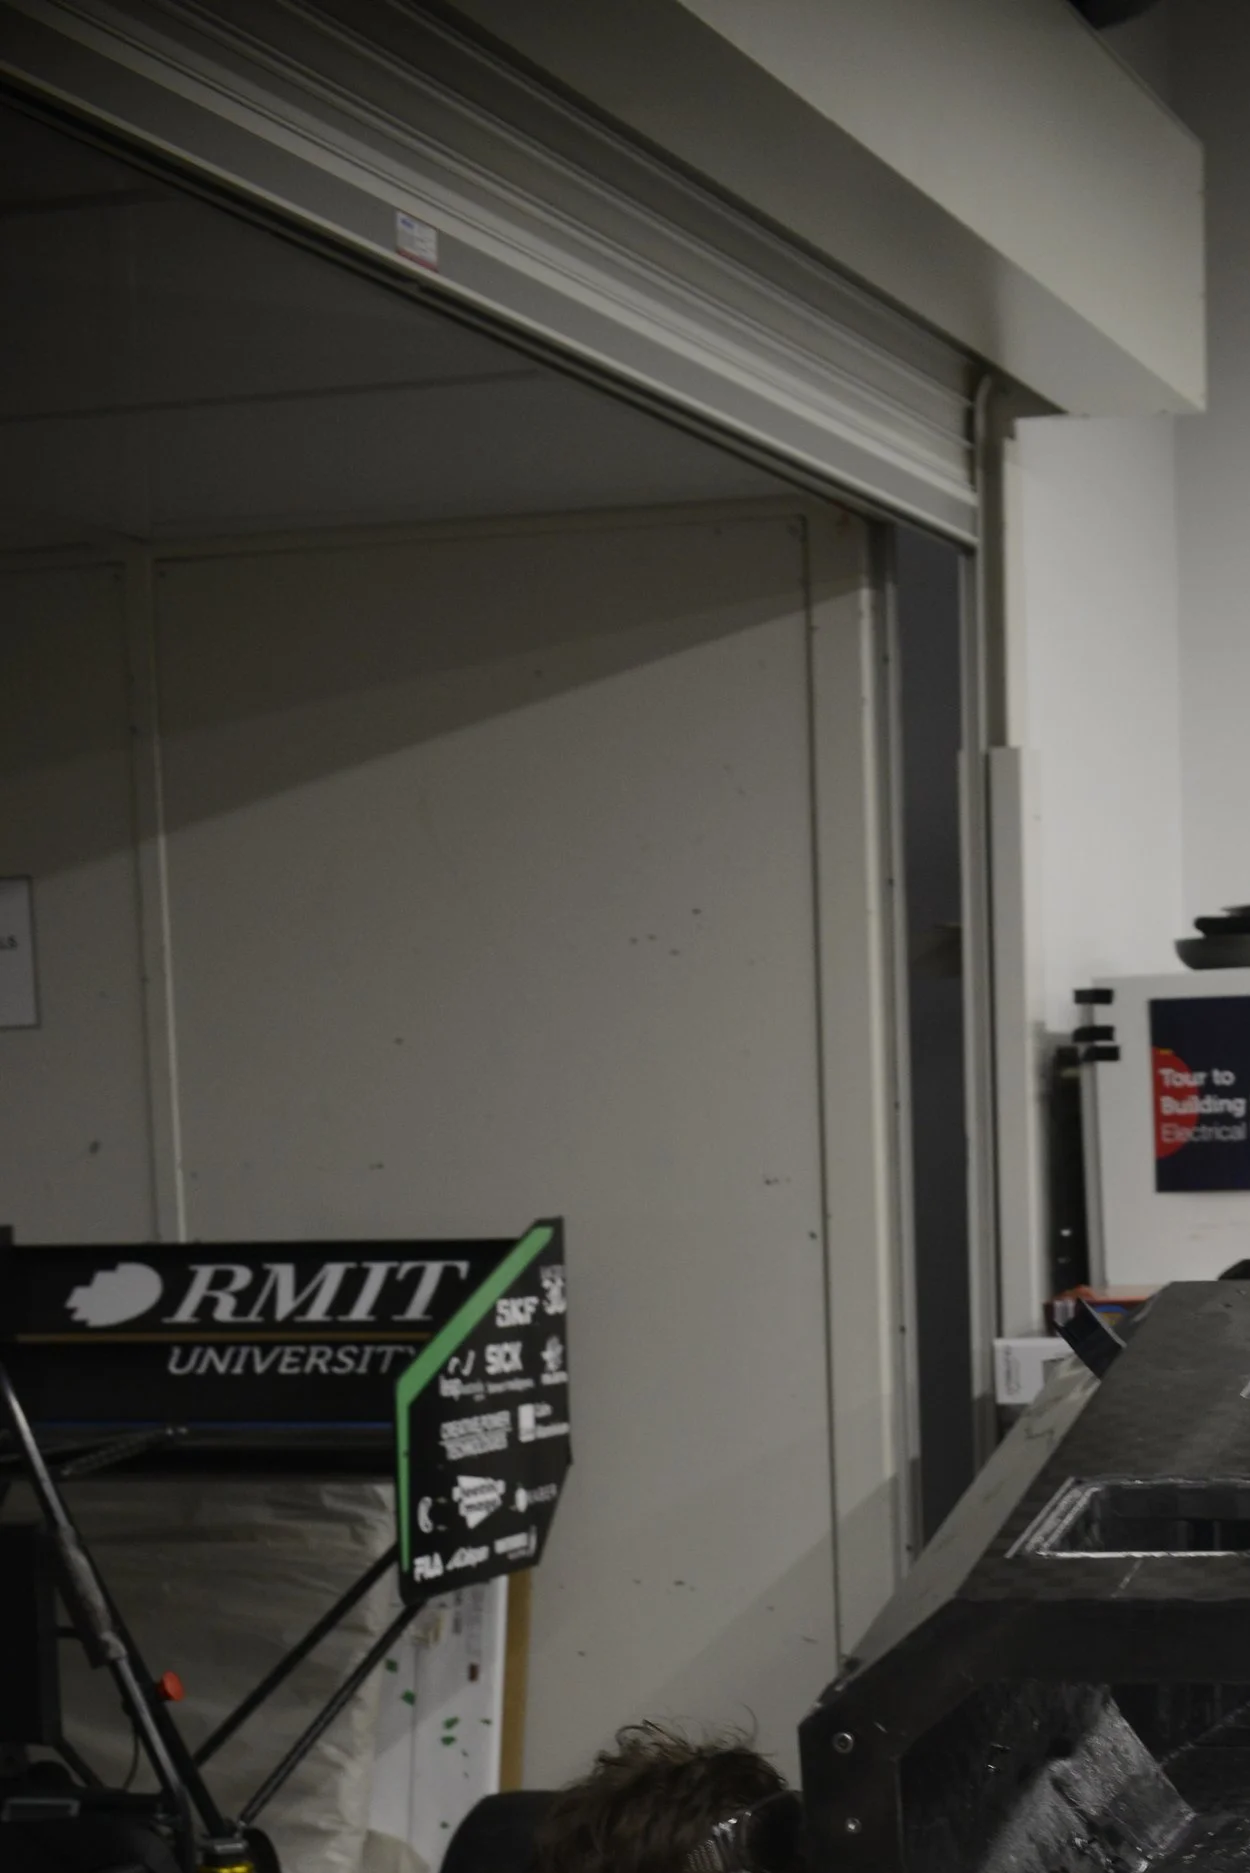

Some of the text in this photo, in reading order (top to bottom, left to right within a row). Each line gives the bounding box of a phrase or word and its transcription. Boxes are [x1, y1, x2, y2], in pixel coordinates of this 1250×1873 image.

[1159, 1068, 1236, 1087] Tour to
[1160, 1093, 1246, 1118] Building
[1160, 1121, 1247, 1144] Electrical
[161, 1260, 469, 1323] RMIT
[495, 1296, 539, 1327] SKF
[167, 1345, 415, 1375] UNIVERSIT
